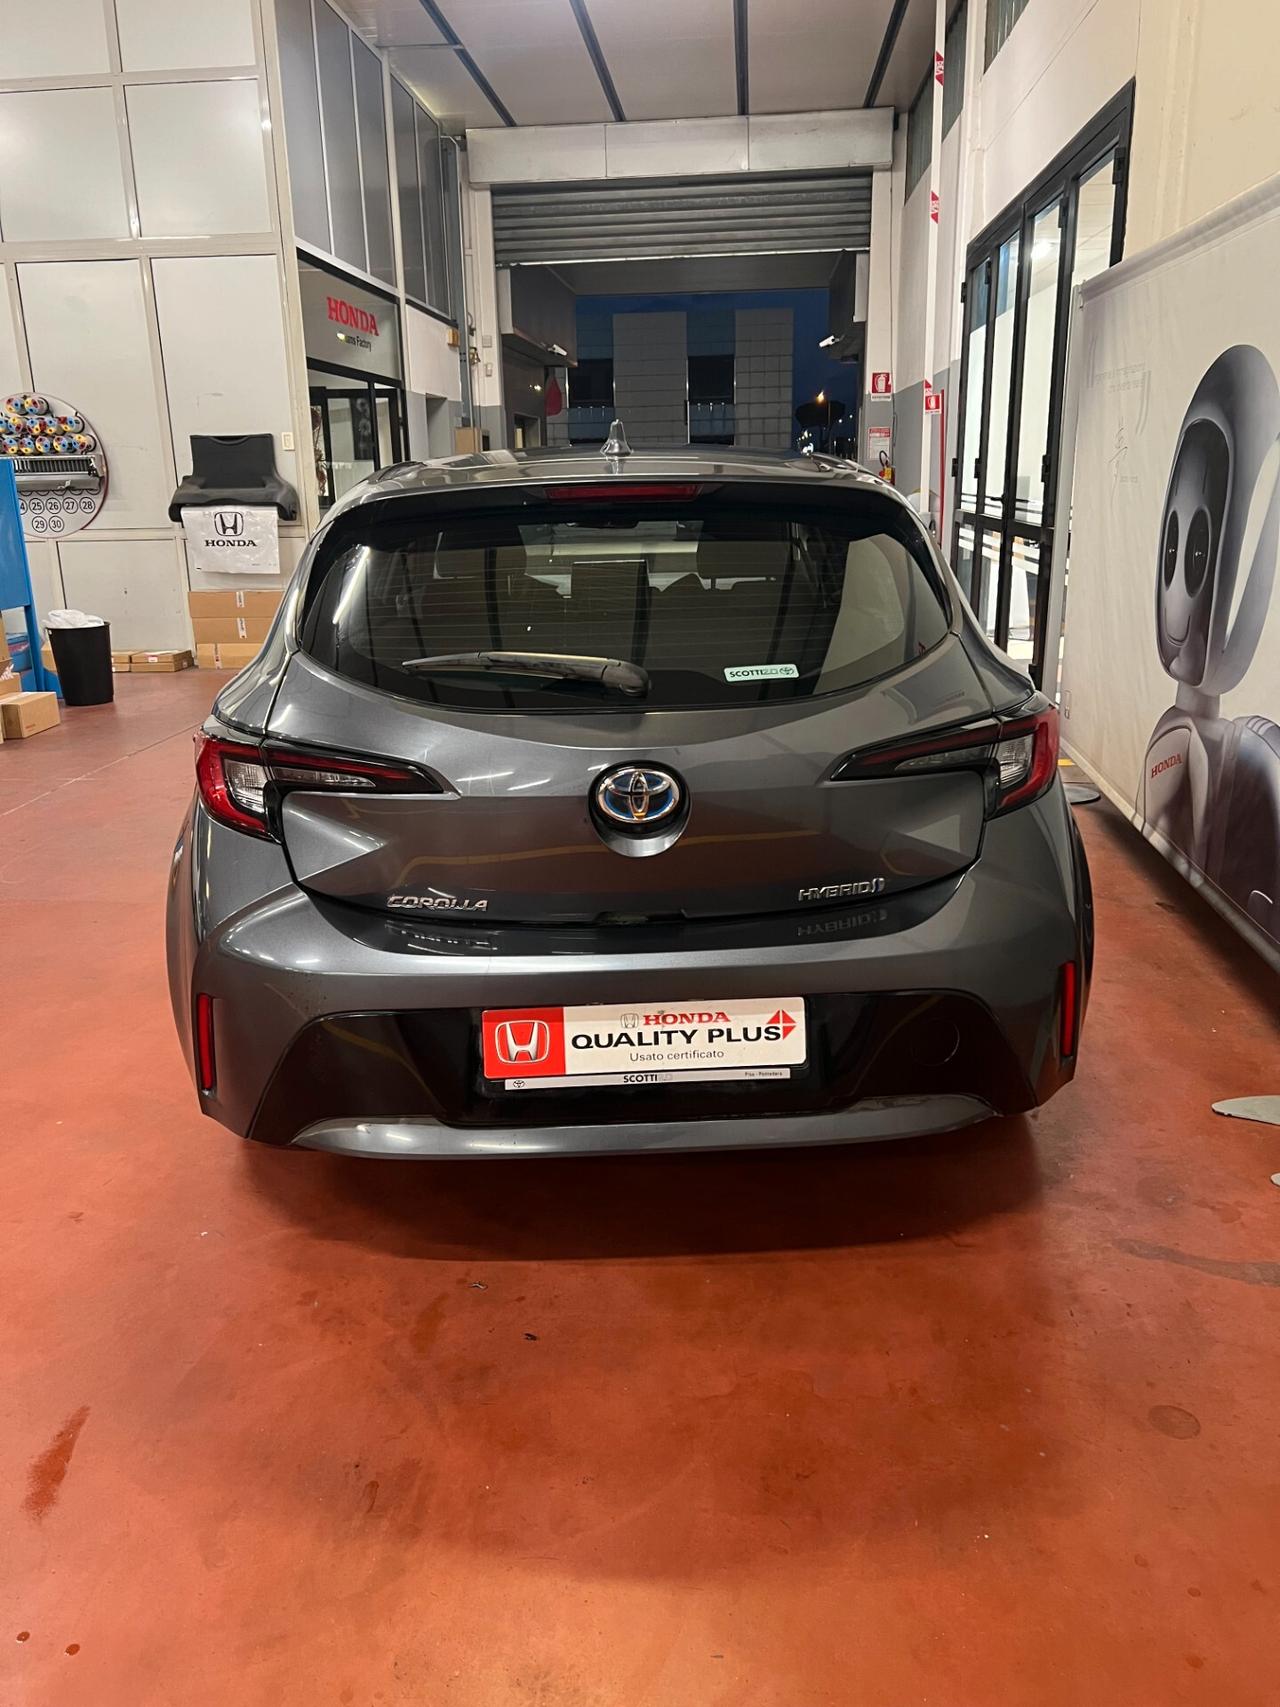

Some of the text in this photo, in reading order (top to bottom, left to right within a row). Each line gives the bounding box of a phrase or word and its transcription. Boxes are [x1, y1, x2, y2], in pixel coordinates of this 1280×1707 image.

[326, 296, 379, 337] HONDA
[32, 501, 42, 511] 25
[49, 501, 59, 511] 26
[65, 500, 75, 511] 27
[82, 499, 93, 510] 28
[34, 518, 62, 530] 29 30
[205, 539, 257, 547] HONDA
[1151, 753, 1183, 778] HONDA
[798, 881, 870, 901] HYBRID
[387, 896, 488, 912] COROLLA
[643, 1010, 731, 1027] HONDA
[571, 1025, 782, 1050] QUALITY PLUS
[629, 1049, 725, 1062] Usato certificato
